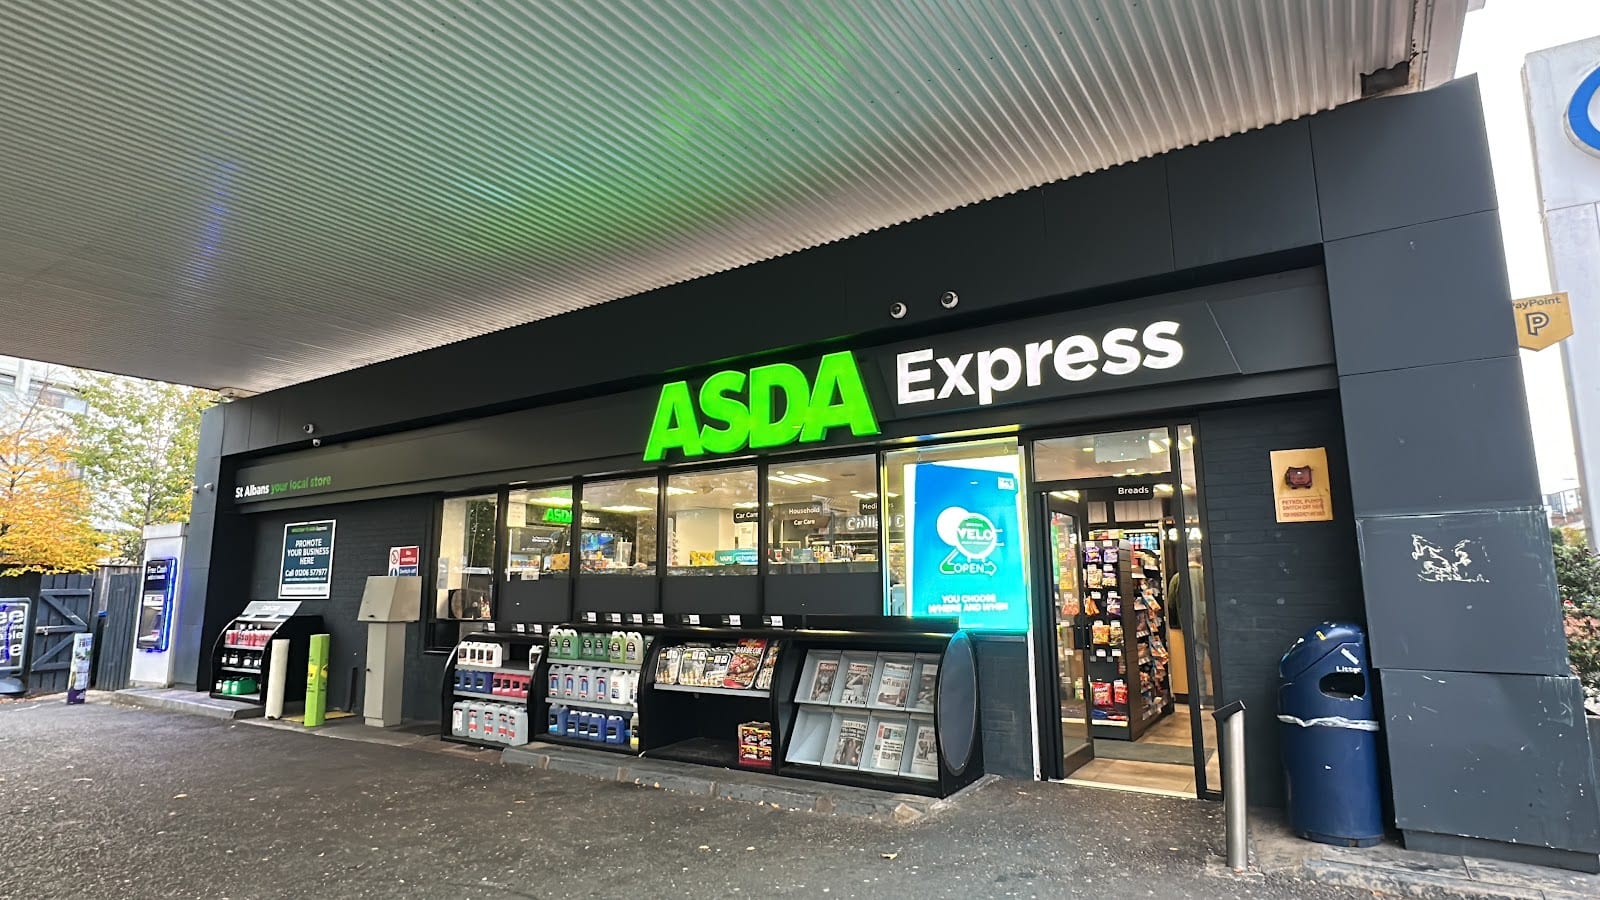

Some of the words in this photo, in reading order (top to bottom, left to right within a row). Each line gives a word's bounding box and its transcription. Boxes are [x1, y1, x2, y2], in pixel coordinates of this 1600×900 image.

[1513, 296, 1562, 309] ayPoint
[642, 350, 882, 462] ASDA
[896, 320, 1184, 406] Express
[235, 487, 243, 498] St
[244, 484, 270, 497] Albans
[271, 482, 288, 494] your
[290, 477, 309, 490] local
[310, 475, 332, 488] store
[1117, 486, 1149, 495] Breads
[545, 508, 572, 524] ASD
[958, 527, 992, 541] VELO
[295, 538, 323, 548] PROMOTE
[288, 548, 303, 557] YOUR
[303, 546, 330, 556] BUSINESS
[300, 556, 315, 565] HERE
[954, 563, 984, 574] OPEN
[942, 594, 960, 604] YOU
[962, 593, 996, 603] CHOOSE
[928, 603, 961, 614] WHERE
[964, 603, 982, 612] AND
[983, 602, 1009, 612] WHEN
[736, 646, 763, 654] BARBECUE
